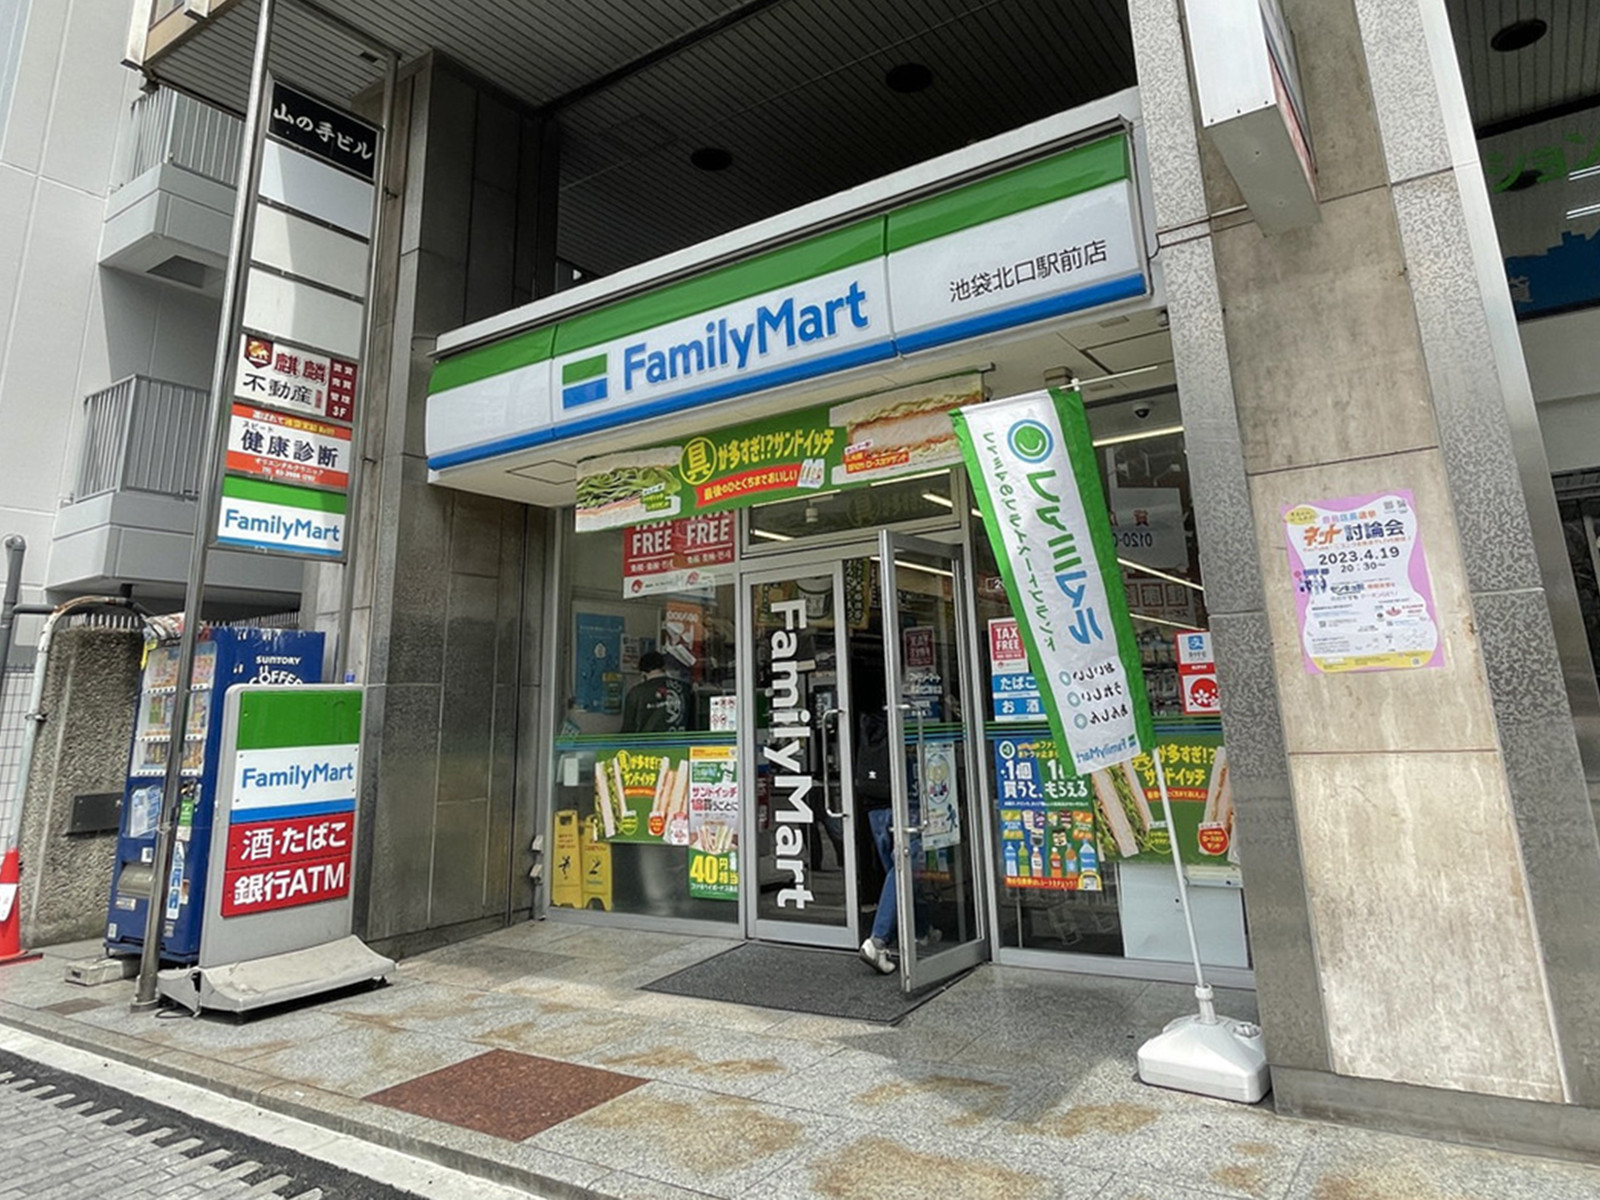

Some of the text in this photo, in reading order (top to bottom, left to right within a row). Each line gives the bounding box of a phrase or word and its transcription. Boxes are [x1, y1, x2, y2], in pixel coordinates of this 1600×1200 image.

[273, 102, 373, 160] 山の手ビル
[949, 239, 1107, 302] 池袋北口駅前店
[624, 281, 869, 392] FamilyMart
[274, 353, 327, 385] 麒麟
[242, 373, 312, 406] 不動産
[332, 406, 347, 418] 3F
[241, 429, 339, 468] 健康診断
[703, 470, 798, 501] 最後のひとくちまでおいしい
[224, 509, 340, 541] FamilyMart
[686, 518, 730, 546] FREE
[1303, 518, 1405, 546] ネット討論会
[632, 529, 672, 555] FREE
[1318, 546, 1400, 565] 2023.4.19
[995, 627, 1019, 640] TAX
[996, 639, 1020, 650] FREE
[255, 655, 303, 665] SUNTORY
[1000, 675, 1037, 691] たばこ
[1002, 699, 1040, 714] お酒
[762, 598, 815, 910] FamilyMart
[241, 763, 354, 789] FamilyMart
[1005, 760, 1033, 780] 1個
[1144, 767, 1206, 787] サドイッチ
[692, 787, 737, 798] サンドイッチ
[1045, 780, 1088, 798] もらえる
[240, 821, 347, 861] 酒・たばこ
[233, 863, 346, 905] 銀行ATM
